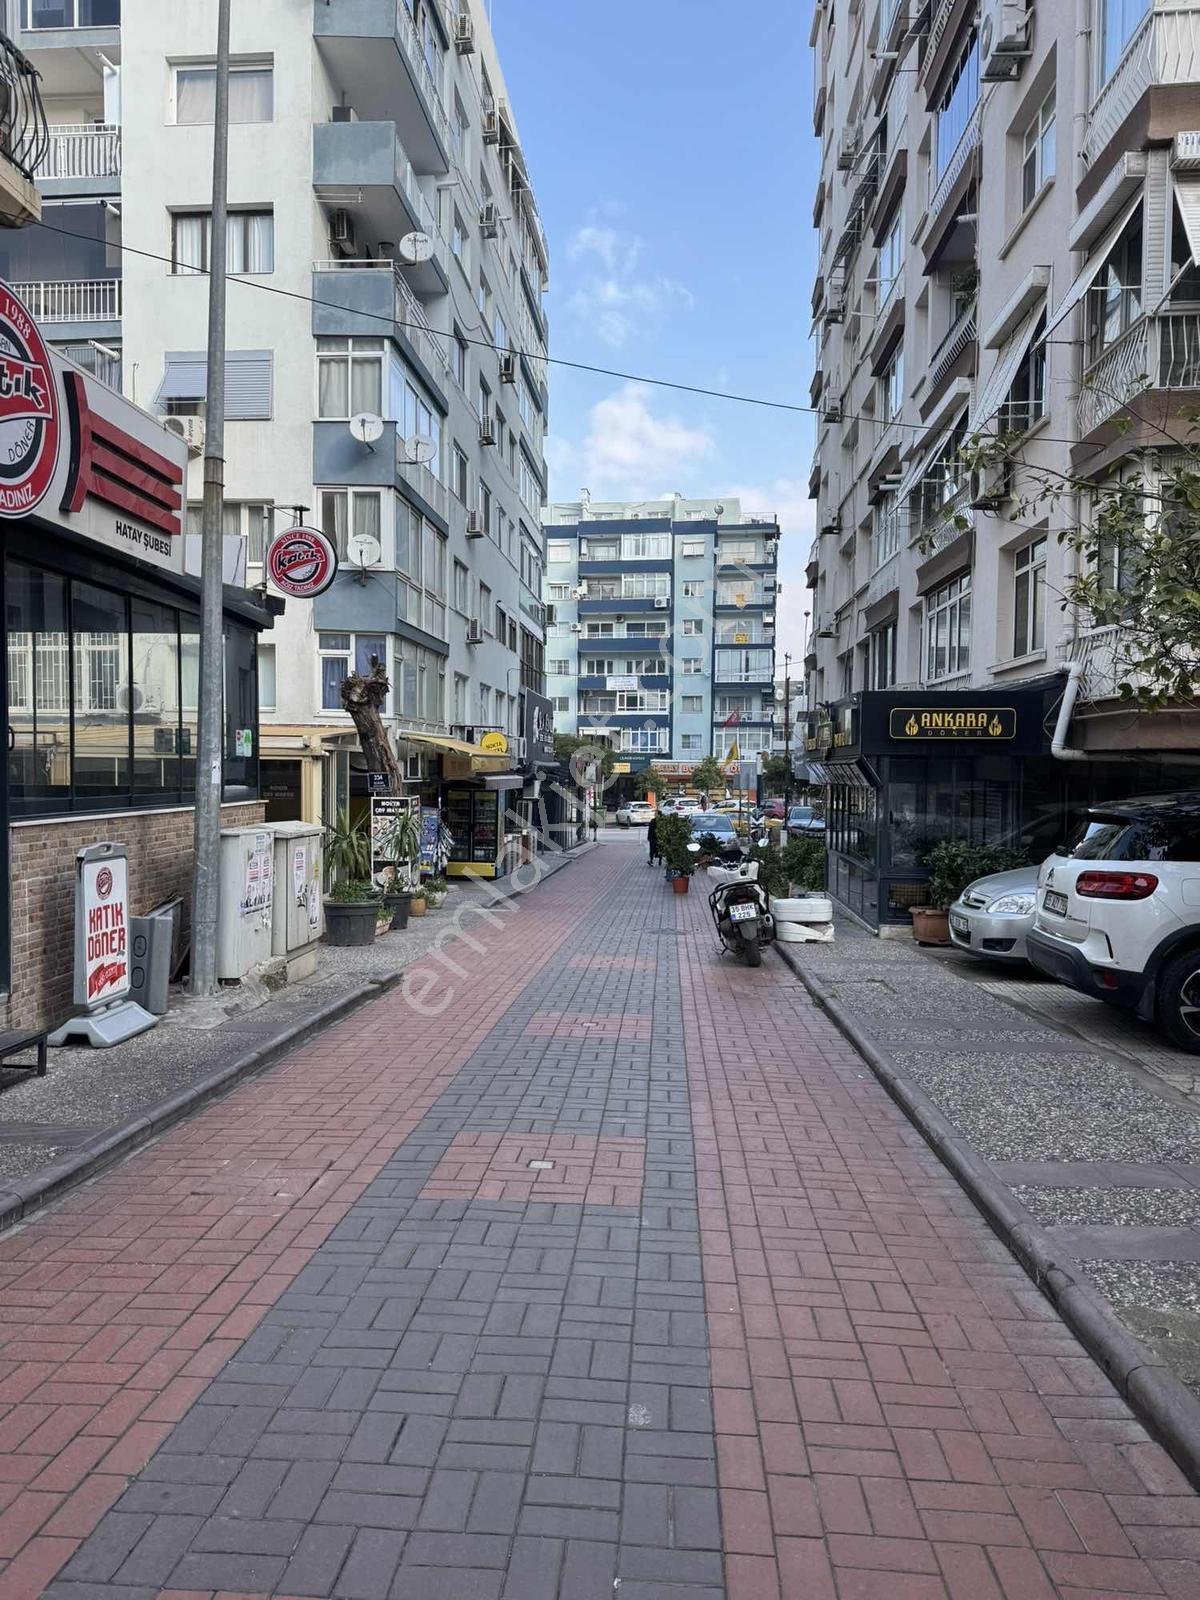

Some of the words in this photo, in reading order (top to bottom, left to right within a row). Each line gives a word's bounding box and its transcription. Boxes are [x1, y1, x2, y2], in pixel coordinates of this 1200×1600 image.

[4, 298, 31, 339] 1988
[8, 420, 35, 462] DÖNER
[116, 520, 142, 544] HATAY
[143, 533, 171, 557] ŞUBESİ
[921, 713, 988, 727] ANKARA
[89, 902, 123, 934] KATIK
[88, 927, 126, 961] DÖNER
